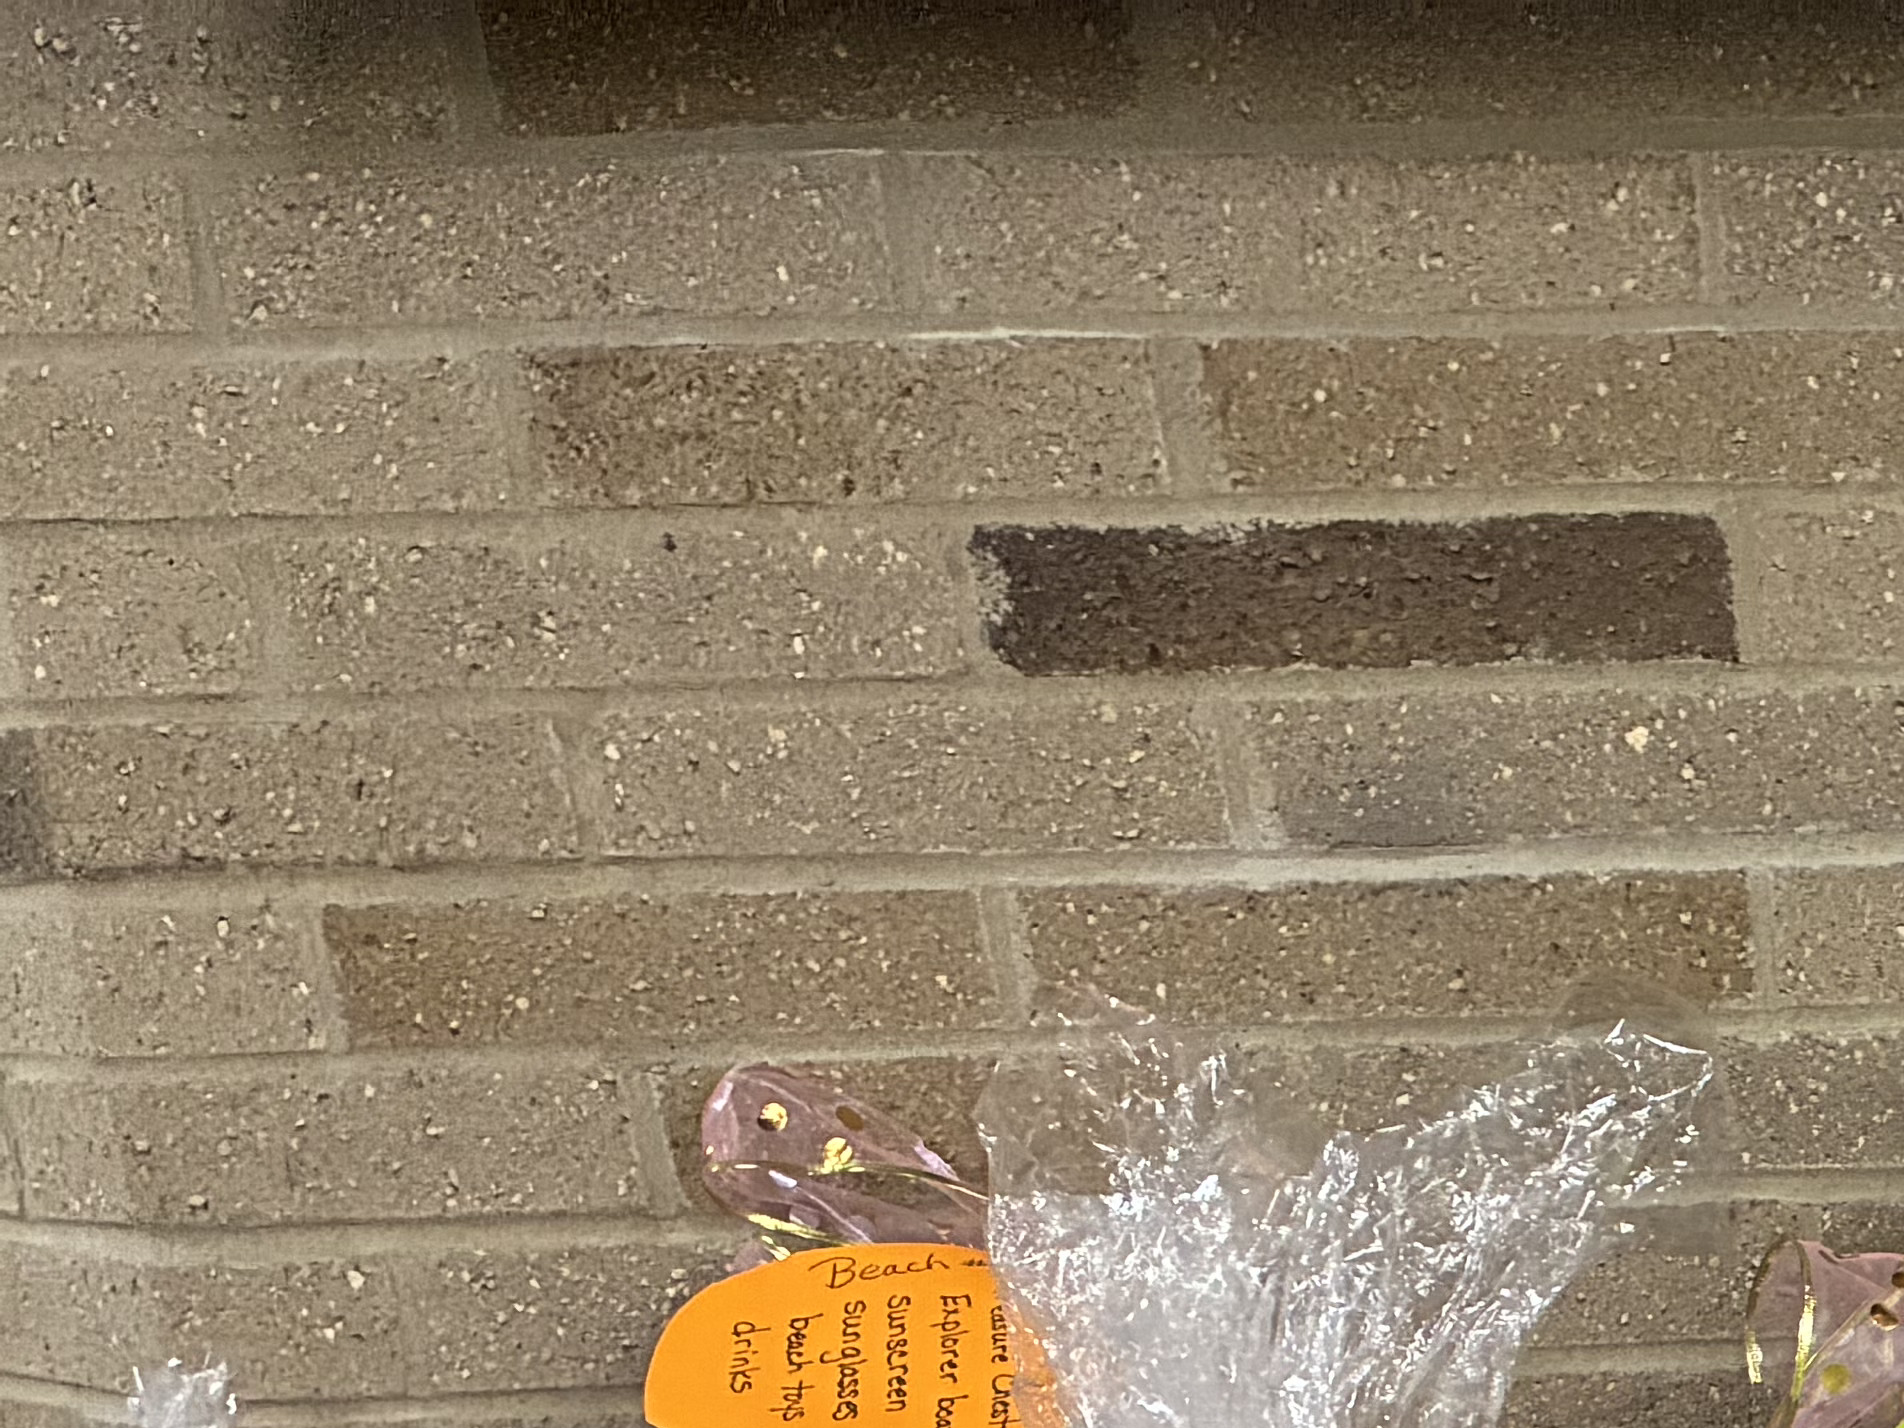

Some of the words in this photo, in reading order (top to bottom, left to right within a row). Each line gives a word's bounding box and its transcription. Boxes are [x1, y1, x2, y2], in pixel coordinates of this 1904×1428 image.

[807, 1252, 951, 1290] Beach
[728, 1320, 772, 1394] drinks
[785, 1312, 825, 1375] beach
[817, 1300, 868, 1422] sunglasses
[884, 1294, 912, 1413] sunscreen
[929, 1293, 972, 1384] Explorer
[768, 1379, 815, 1422] toys
